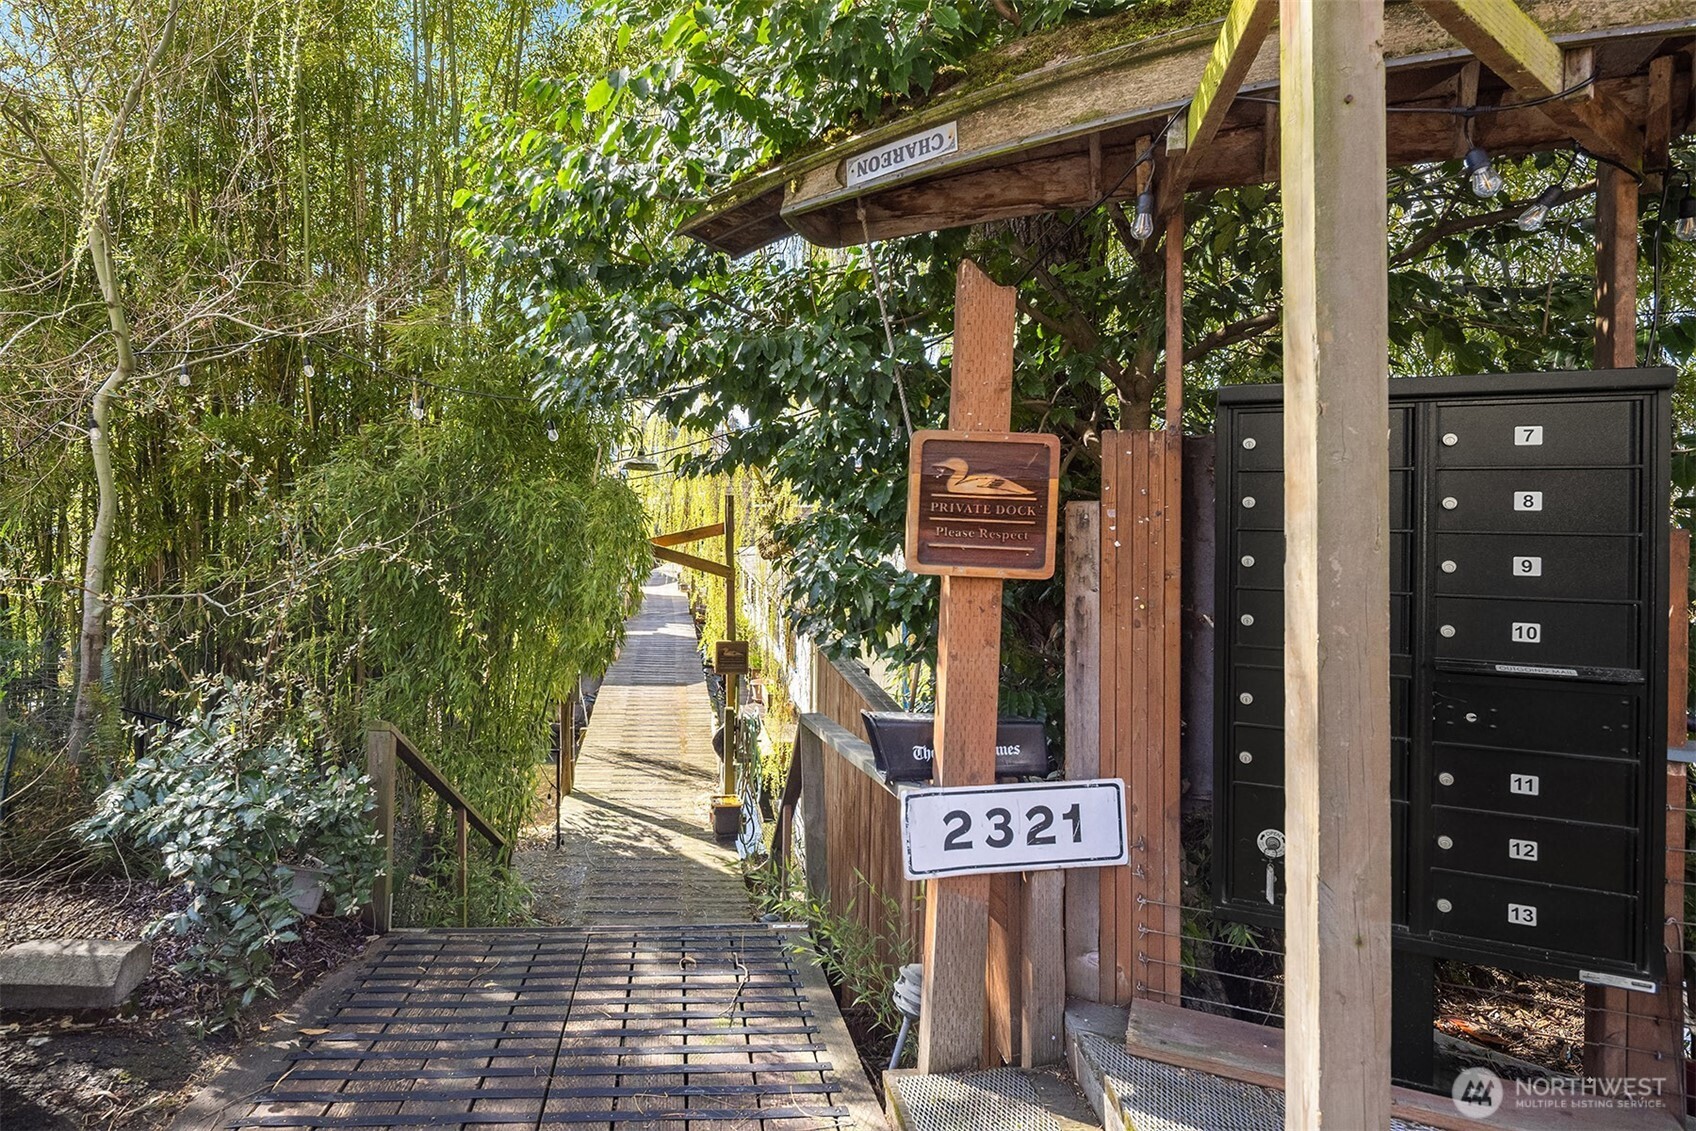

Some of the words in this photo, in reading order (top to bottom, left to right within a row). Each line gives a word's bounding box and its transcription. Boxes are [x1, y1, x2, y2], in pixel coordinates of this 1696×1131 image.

[857, 133, 944, 178] CHAREON
[1523, 429, 1534, 442] 7
[1523, 494, 1534, 508] 8
[930, 502, 991, 514] PRIVATE
[996, 505, 1036, 516] DOCK
[936, 527, 975, 538] Please
[979, 528, 1028, 542] Respect
[1521, 559, 1533, 573] 9
[1515, 626, 1537, 639] 10
[1514, 777, 1533, 792] 11
[942, 803, 1082, 852] 2321
[1512, 842, 1535, 858] 12
[1511, 907, 1534, 923] 13
